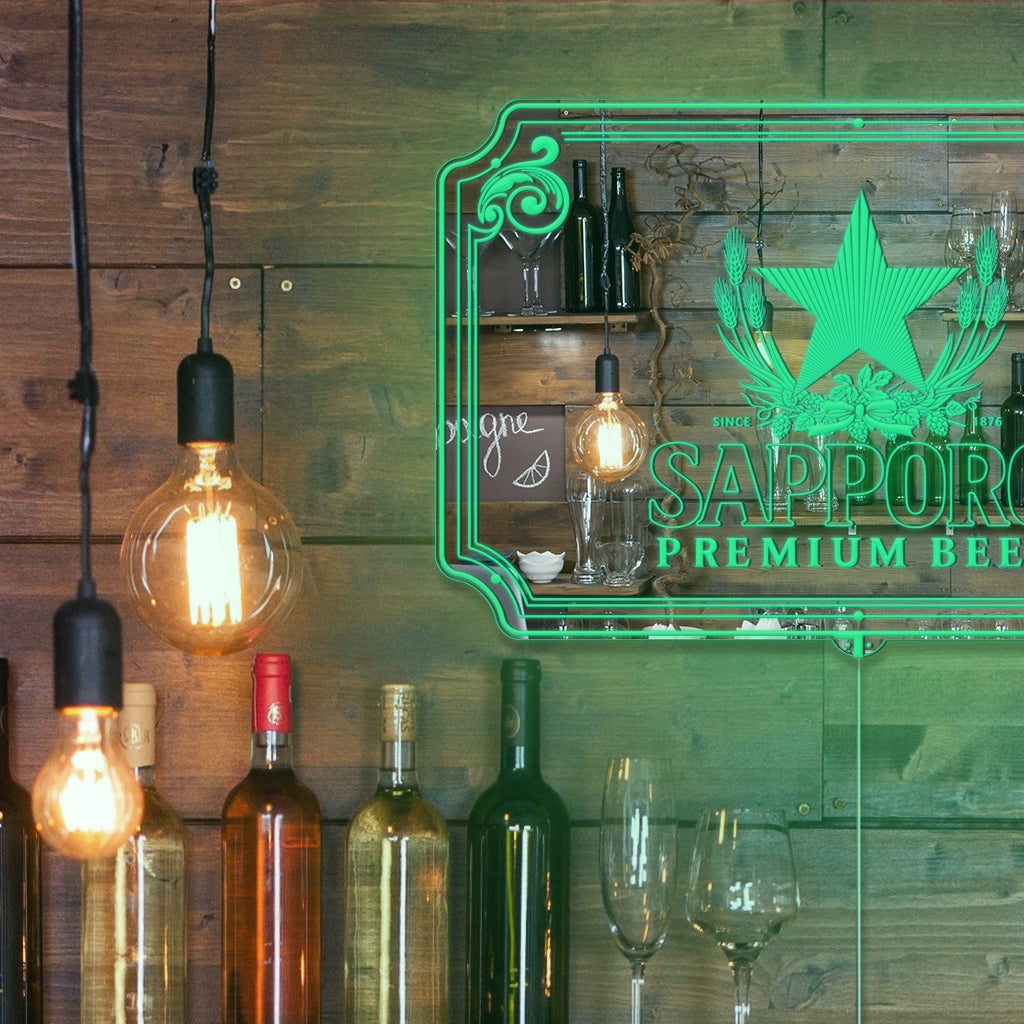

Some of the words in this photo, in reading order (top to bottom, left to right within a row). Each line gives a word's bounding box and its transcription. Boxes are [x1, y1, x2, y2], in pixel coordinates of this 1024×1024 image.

[712, 416, 751, 427] SINCE
[972, 416, 1003, 427] 1876
[656, 537, 906, 568] PREMIUM
